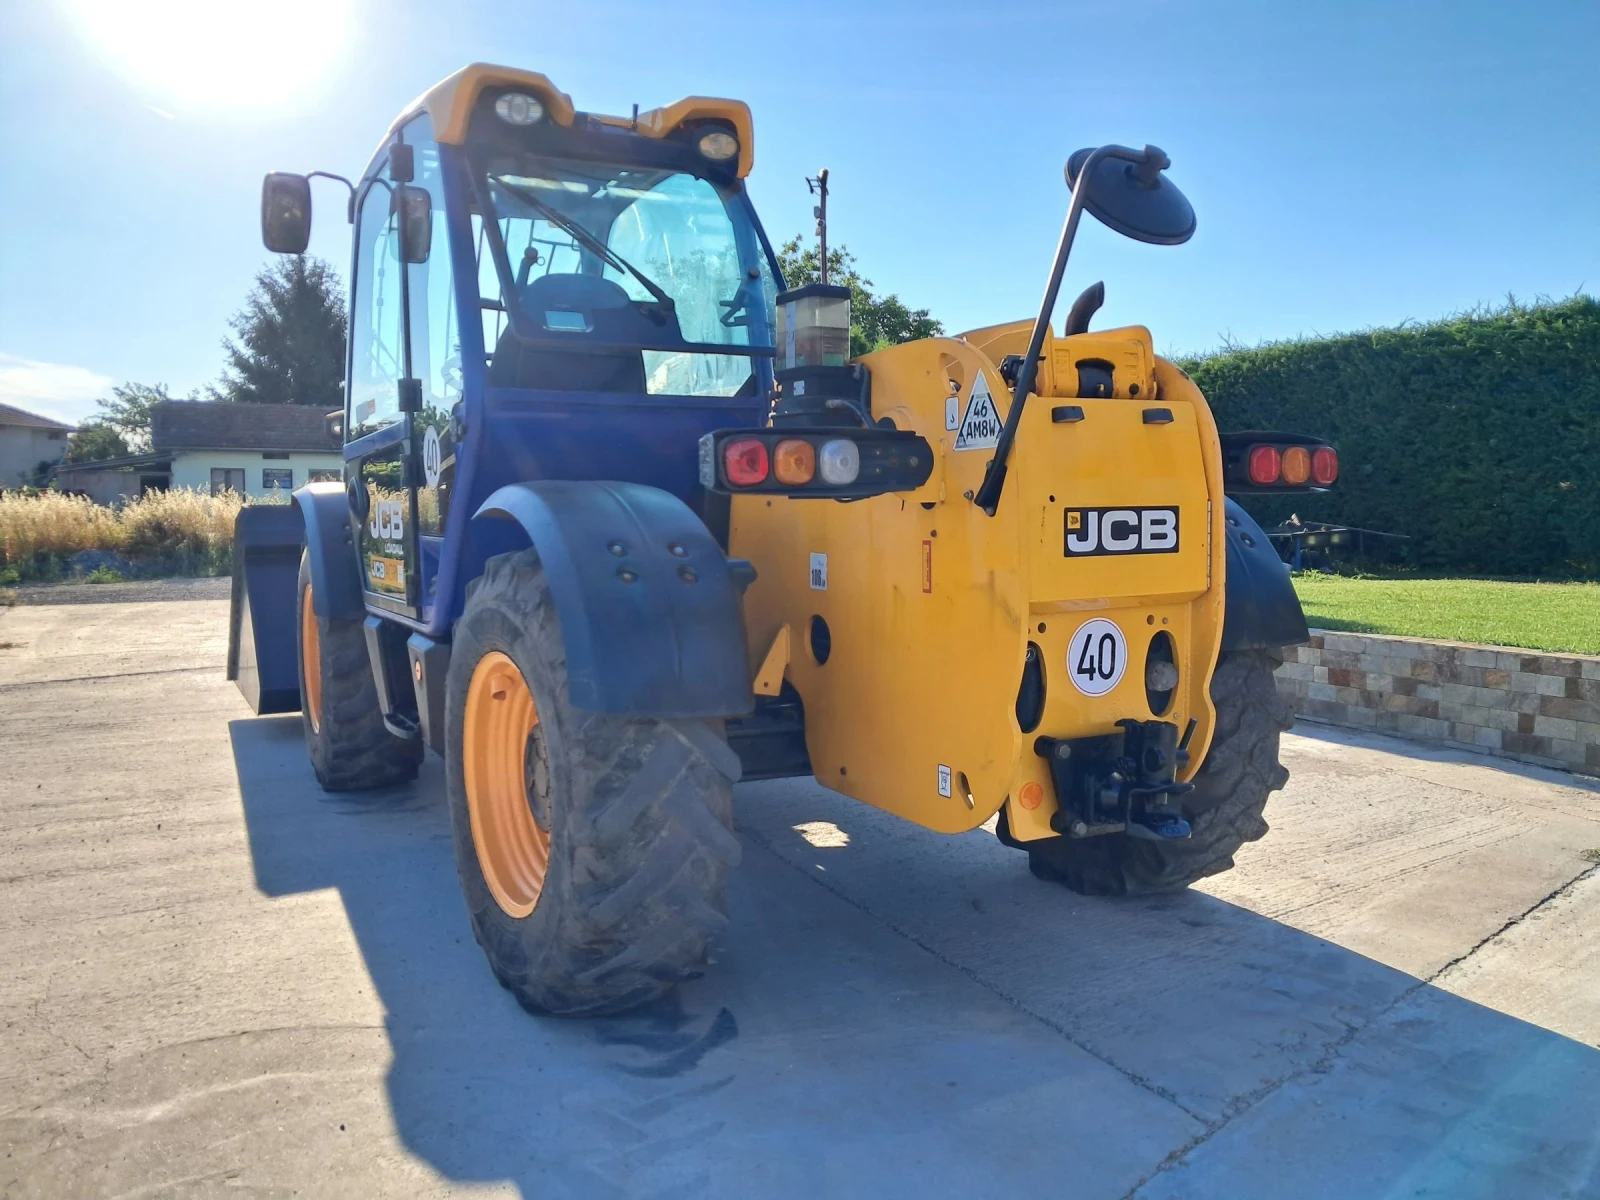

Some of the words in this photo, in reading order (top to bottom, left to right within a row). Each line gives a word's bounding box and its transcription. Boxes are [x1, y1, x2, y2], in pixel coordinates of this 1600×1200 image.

[973, 400, 988, 419] 46
[426, 438, 438, 477] 40
[370, 501, 404, 539] JCB
[1066, 509, 1177, 553] JCB
[371, 560, 386, 579] JCB
[1076, 632, 1117, 681] 40
